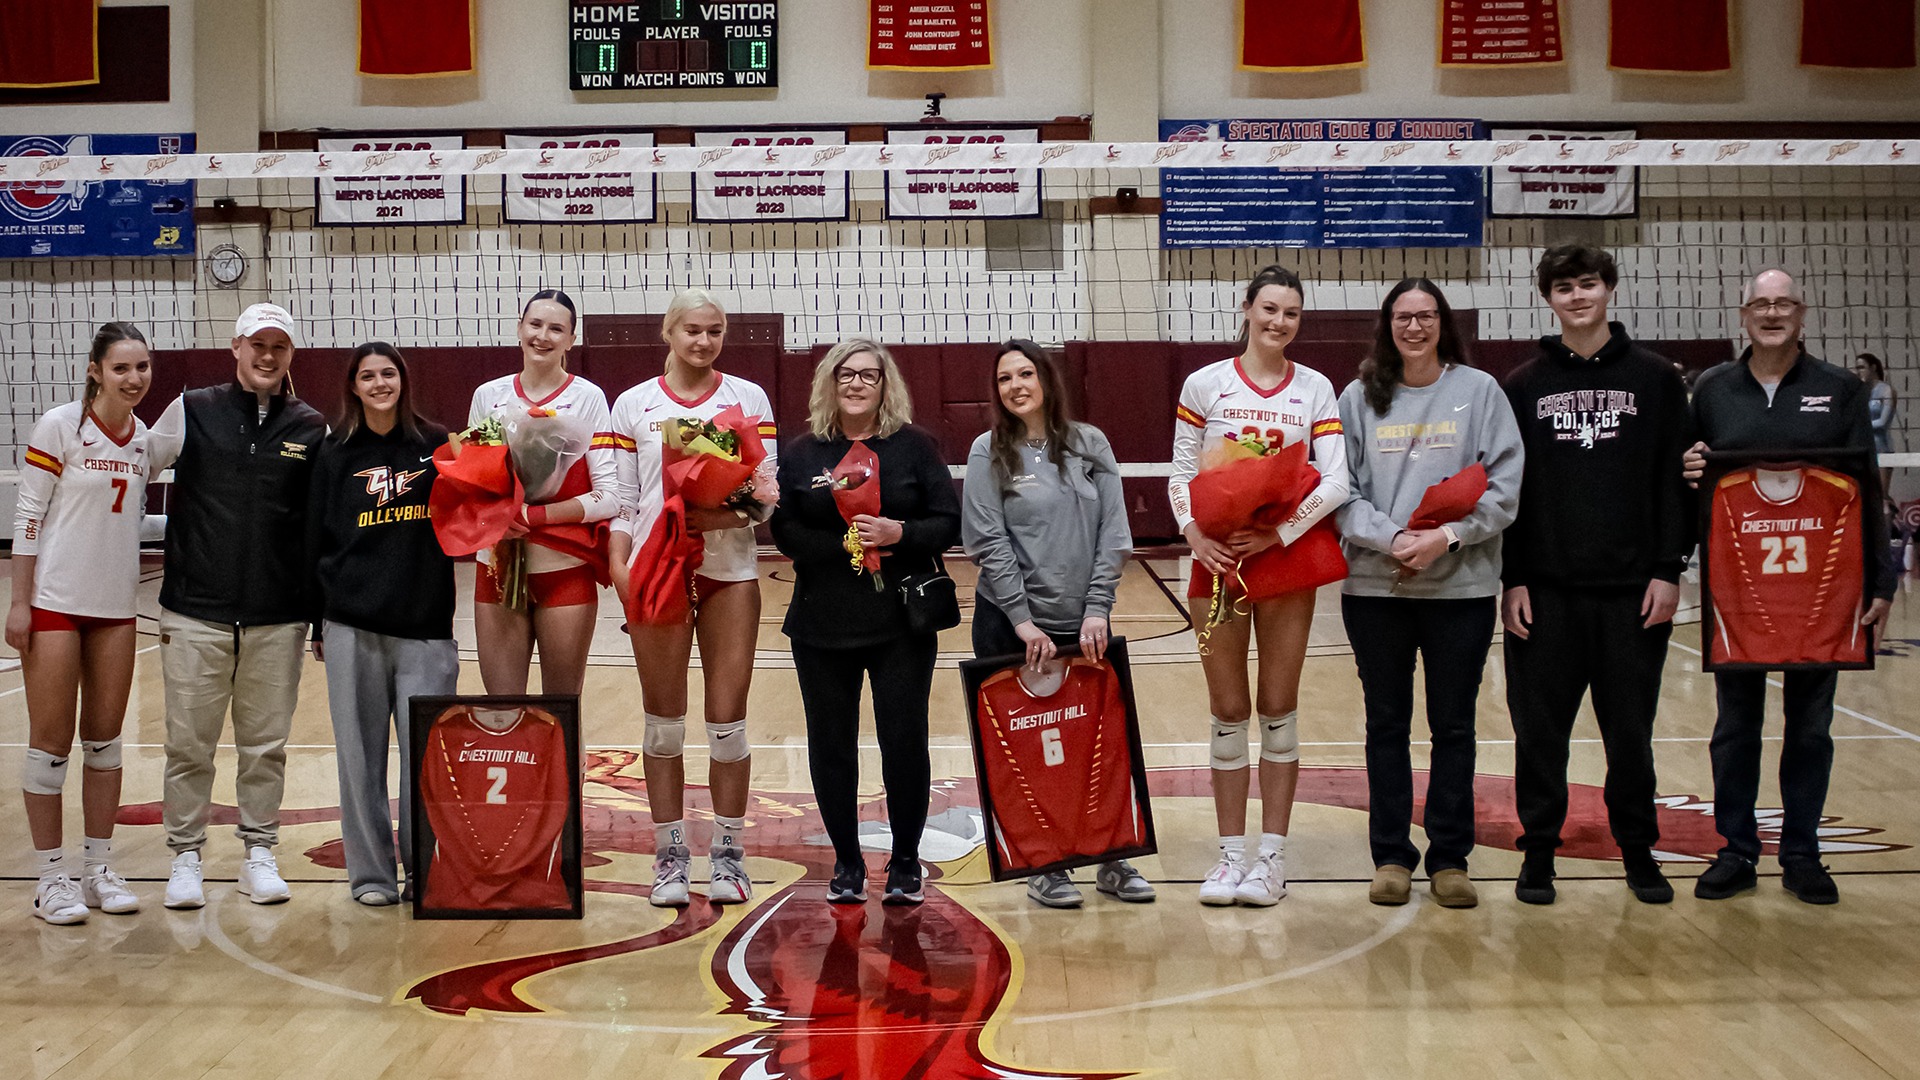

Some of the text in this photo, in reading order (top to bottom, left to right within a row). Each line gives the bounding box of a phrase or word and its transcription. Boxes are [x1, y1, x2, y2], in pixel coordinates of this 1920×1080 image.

[573, 6, 640, 23] HOME
[700, 4, 776, 21] VISITOR
[573, 28, 621, 40] FOULS
[645, 26, 700, 39] PLAYER
[724, 25, 772, 38] FOULS
[750, 41, 766, 68] 0
[581, 74, 613, 87] WON
[624, 72, 725, 86] MATCH POINTS
[735, 72, 767, 84] WON
[1229, 120, 1475, 140] SPECTATOR CODE OF CONDUCT
[336, 188, 445, 201] MEN'S LACROSSE
[524, 186, 635, 199] MEN'S LACROSSE
[714, 184, 826, 197] MEN'S LACROSSE
[908, 181, 1020, 194] MEN'S LACROSSE
[1520, 181, 1606, 194] MEN'S TENNIS
[376, 206, 403, 217] 2021
[564, 203, 594, 215] 2022
[756, 202, 785, 213] 2023
[949, 199, 978, 210] 2024
[1548, 199, 1578, 210] 2017
[1537, 389, 1638, 420] CHESTNUT HILL
[1223, 408, 1304, 427] CHESTNUT HILL
[1553, 410, 1621, 430] COLLEGE
[84, 458, 130, 474] CHESTNUT
[111, 477, 128, 514] 7
[358, 504, 432, 528] OLLEYBALL
[1286, 494, 1324, 527] GRIFFINS
[1741, 517, 1824, 534] CHESTNUT HILL
[1760, 535, 1808, 575] 23
[1010, 703, 1088, 732] CHESTNUT HILL
[1040, 726, 1066, 767] 6
[459, 749, 538, 765] CHESTNUT HILL
[486, 766, 508, 805] 2
